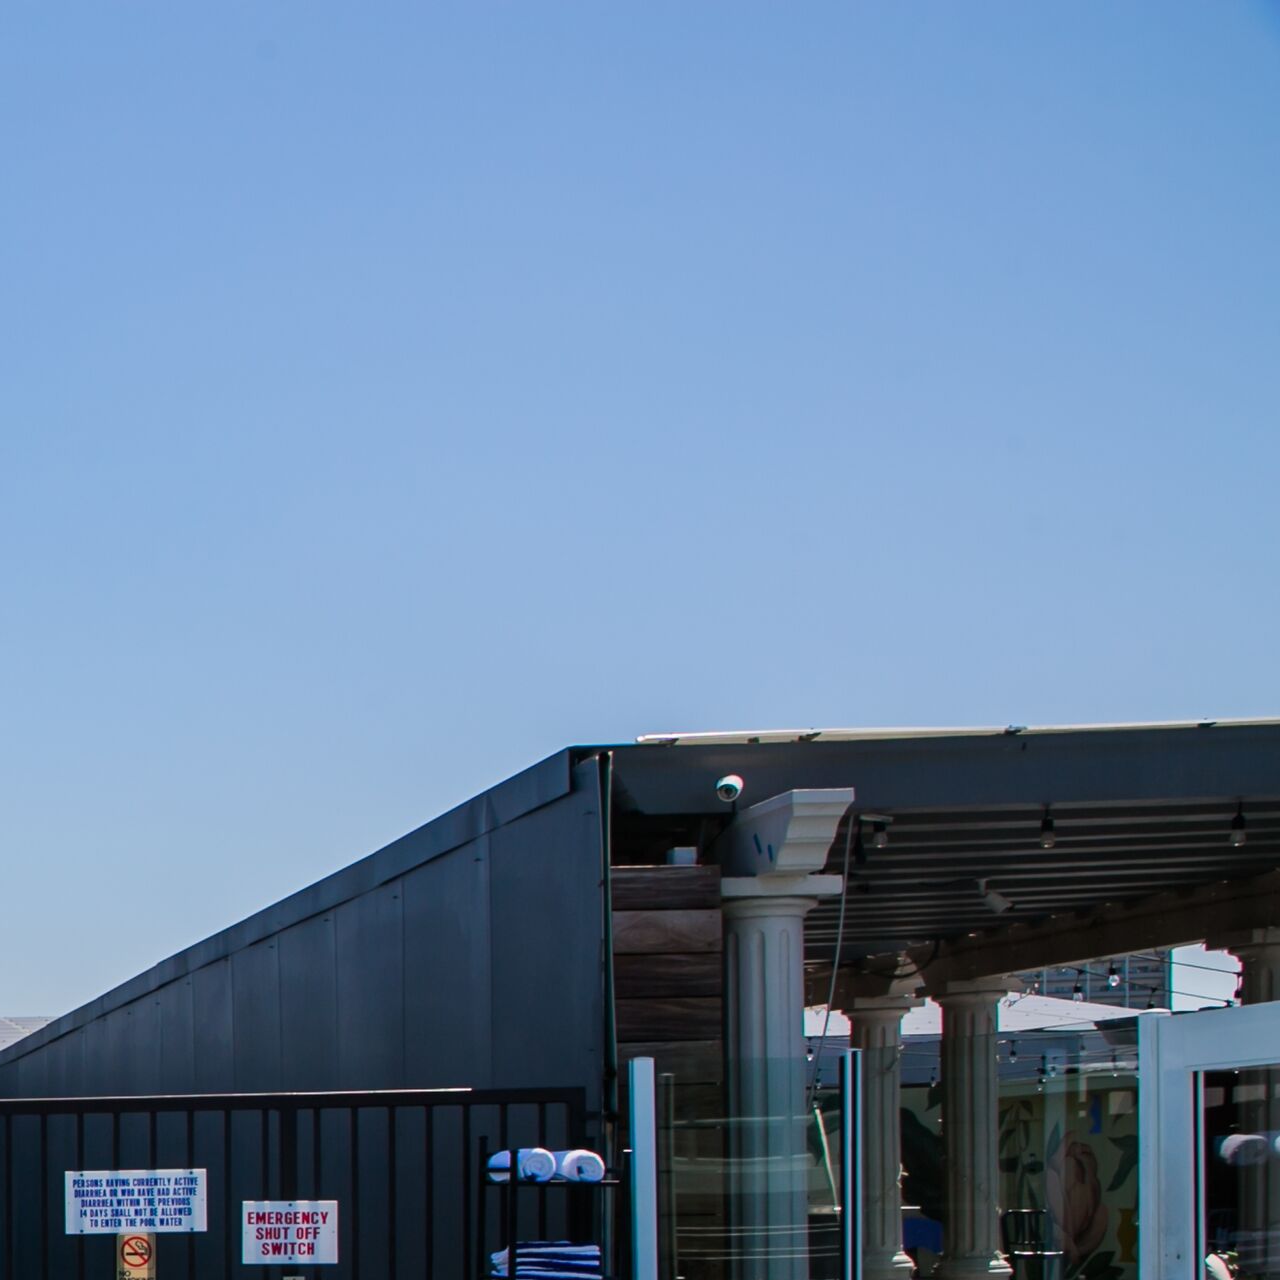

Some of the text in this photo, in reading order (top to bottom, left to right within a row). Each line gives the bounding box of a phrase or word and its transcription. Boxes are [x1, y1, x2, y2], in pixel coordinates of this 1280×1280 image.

[73, 1177, 198, 1188] PERSONS HAVING CURRENTLY ACTIVE
[74, 1187, 197, 1198] DIARRHEA OR WHO HAVE HAD ACTIVE
[81, 1198, 191, 1208] DIARRHEA WITHIN THE PREVIOUS
[80, 1207, 192, 1218] 14 DAYS SHALL NOT BE ALLOWED
[247, 1211, 328, 1225] EMERGENCY
[90, 1218, 182, 1228] TO ENTER THE POOL WATER
[255, 1227, 320, 1240] SHUT OFF
[261, 1242, 315, 1255] SWITCH
